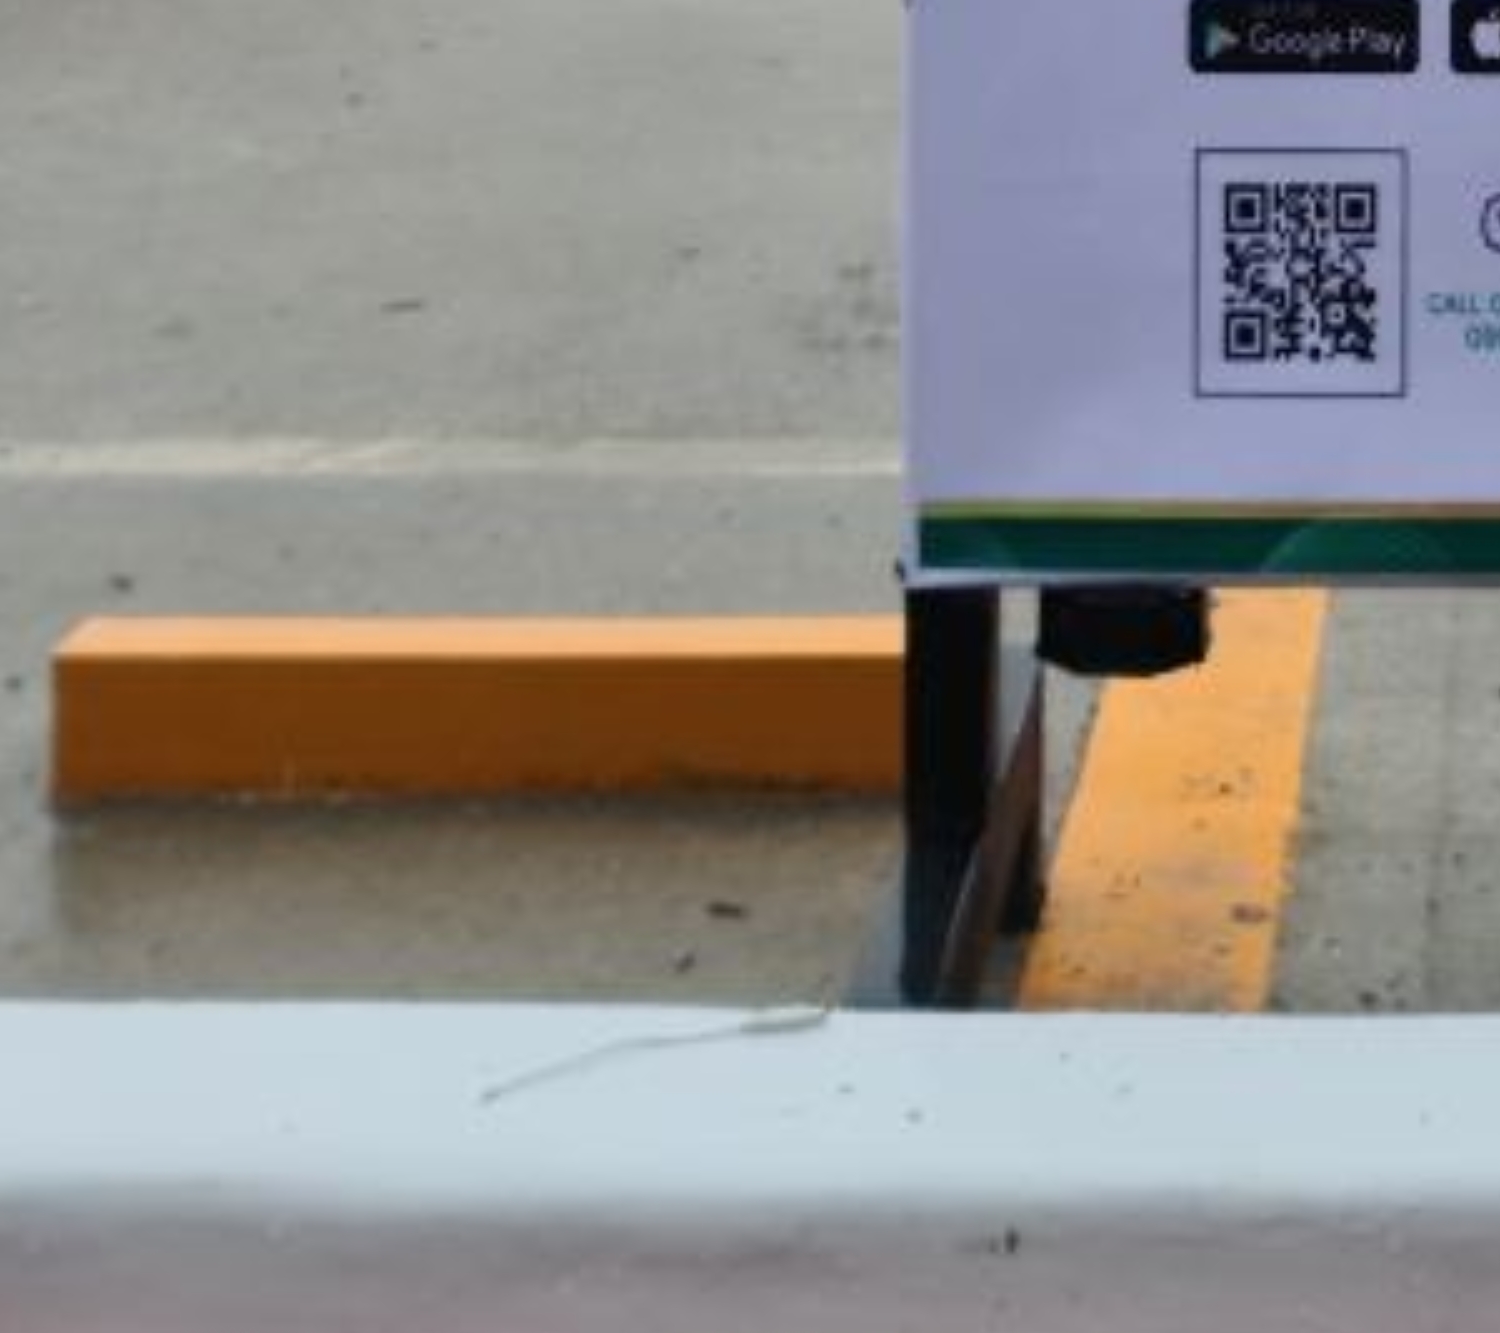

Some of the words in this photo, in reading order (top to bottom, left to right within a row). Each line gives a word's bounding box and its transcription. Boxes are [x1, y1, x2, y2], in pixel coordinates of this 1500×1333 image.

[1249, 23, 1341, 62] Google
[1349, 24, 1406, 61] Play
[1426, 293, 1482, 314] CALL
